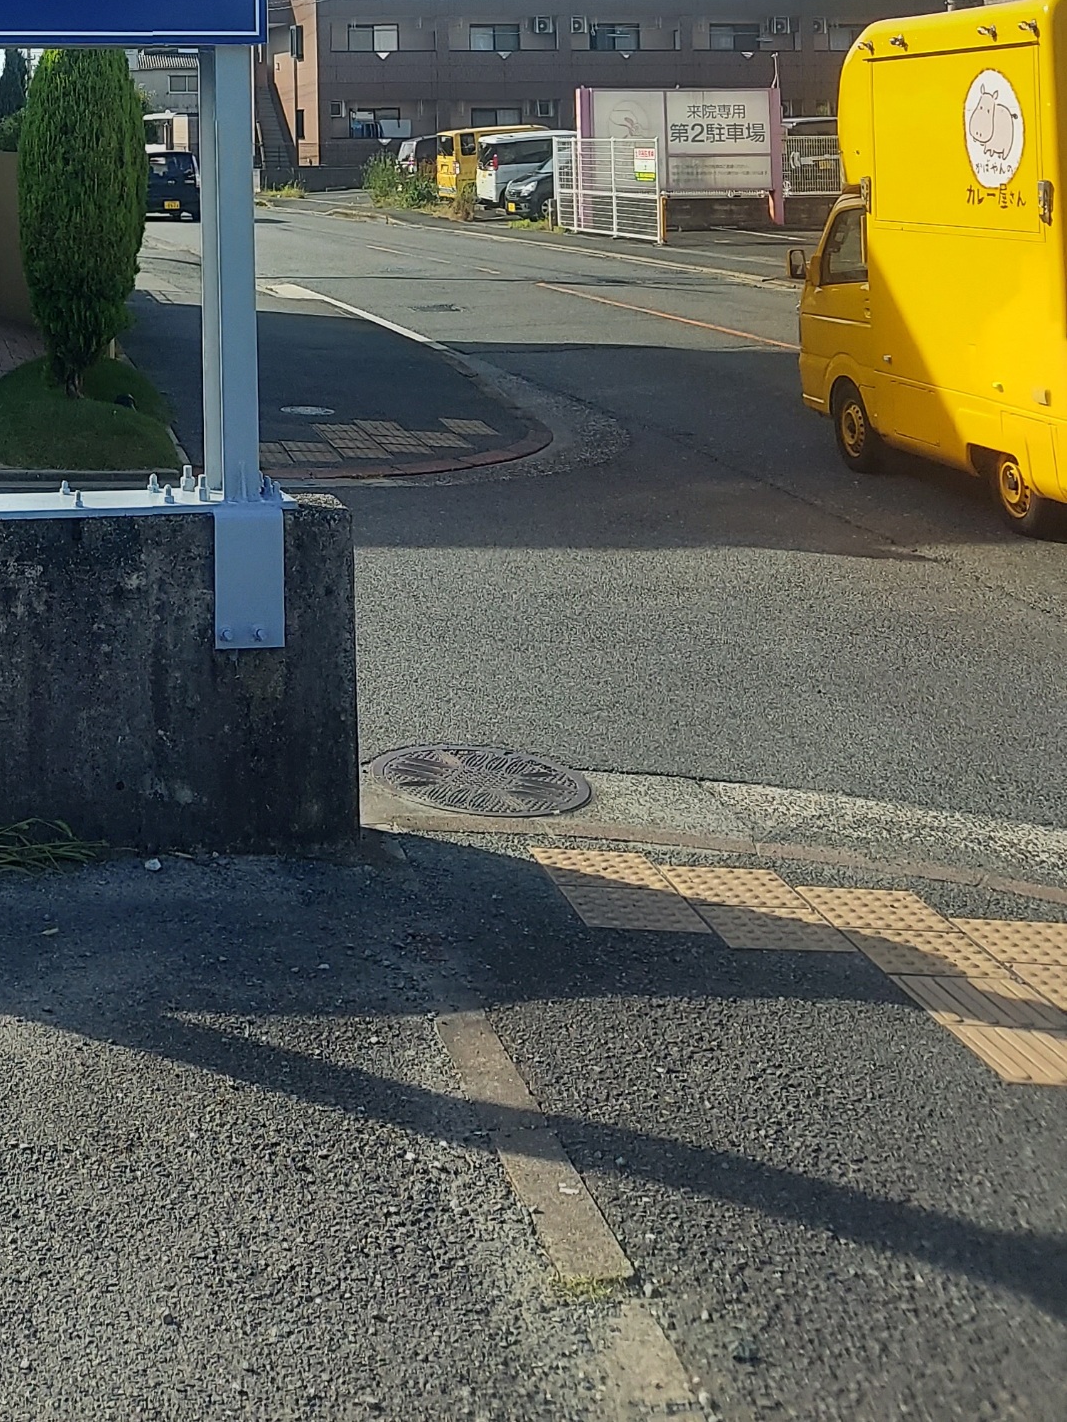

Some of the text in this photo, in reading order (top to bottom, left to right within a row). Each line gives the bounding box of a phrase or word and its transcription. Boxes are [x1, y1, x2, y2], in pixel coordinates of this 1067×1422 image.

[686, 104, 747, 120] 来院専用
[669, 123, 766, 144] 第2駐車場
[966, 183, 1027, 209] カレー屋さん
